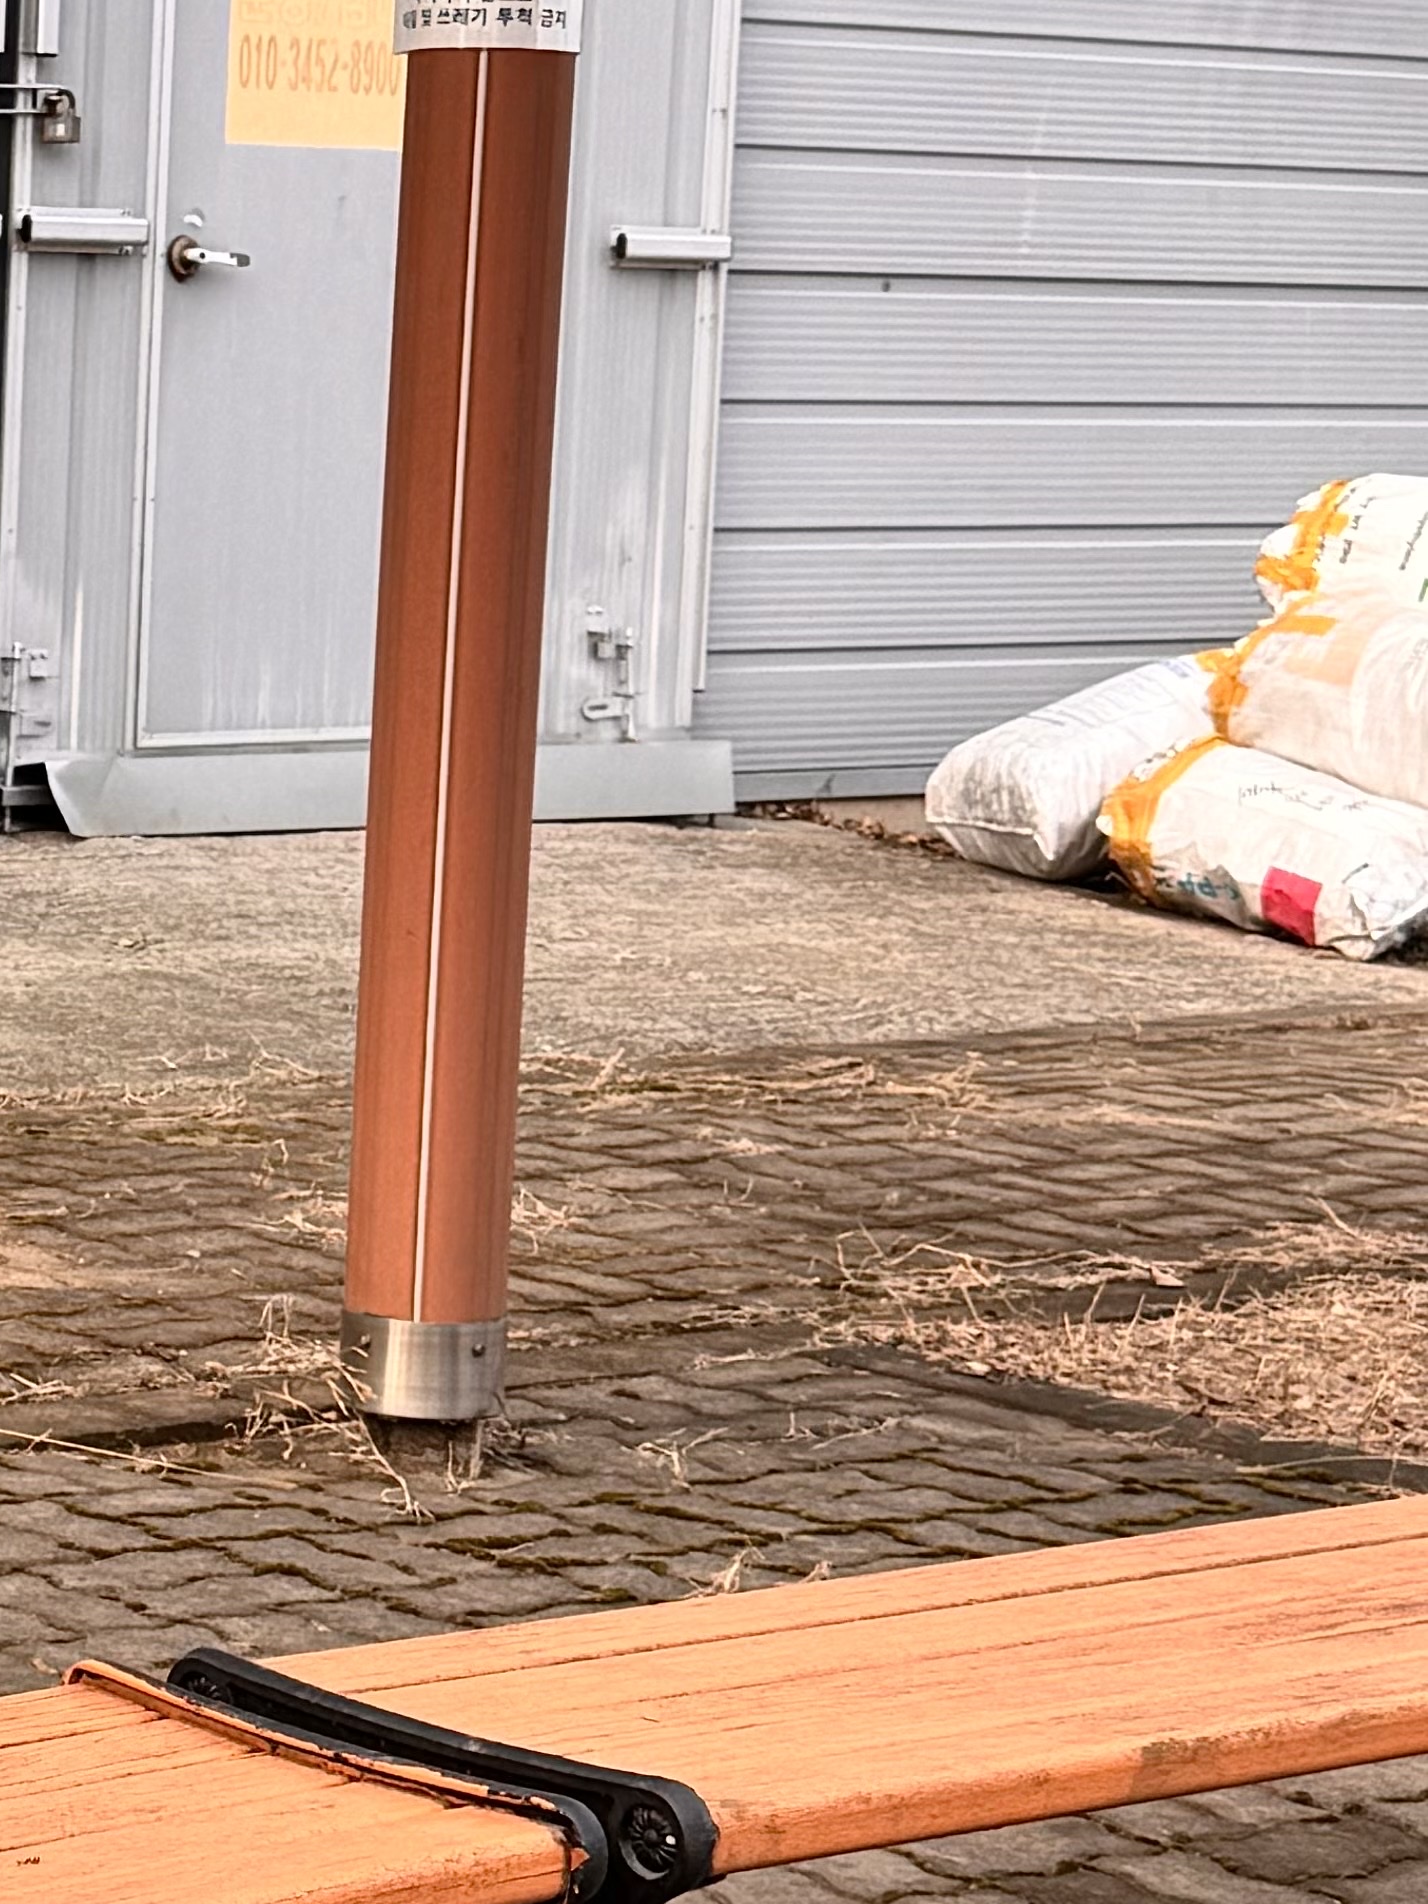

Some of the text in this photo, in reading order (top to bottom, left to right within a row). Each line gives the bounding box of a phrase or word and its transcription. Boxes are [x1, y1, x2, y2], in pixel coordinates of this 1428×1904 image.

[437, 7, 488, 27] 쓰레기
[496, 7, 533, 27] 투척
[540, 8, 567, 29] 금지
